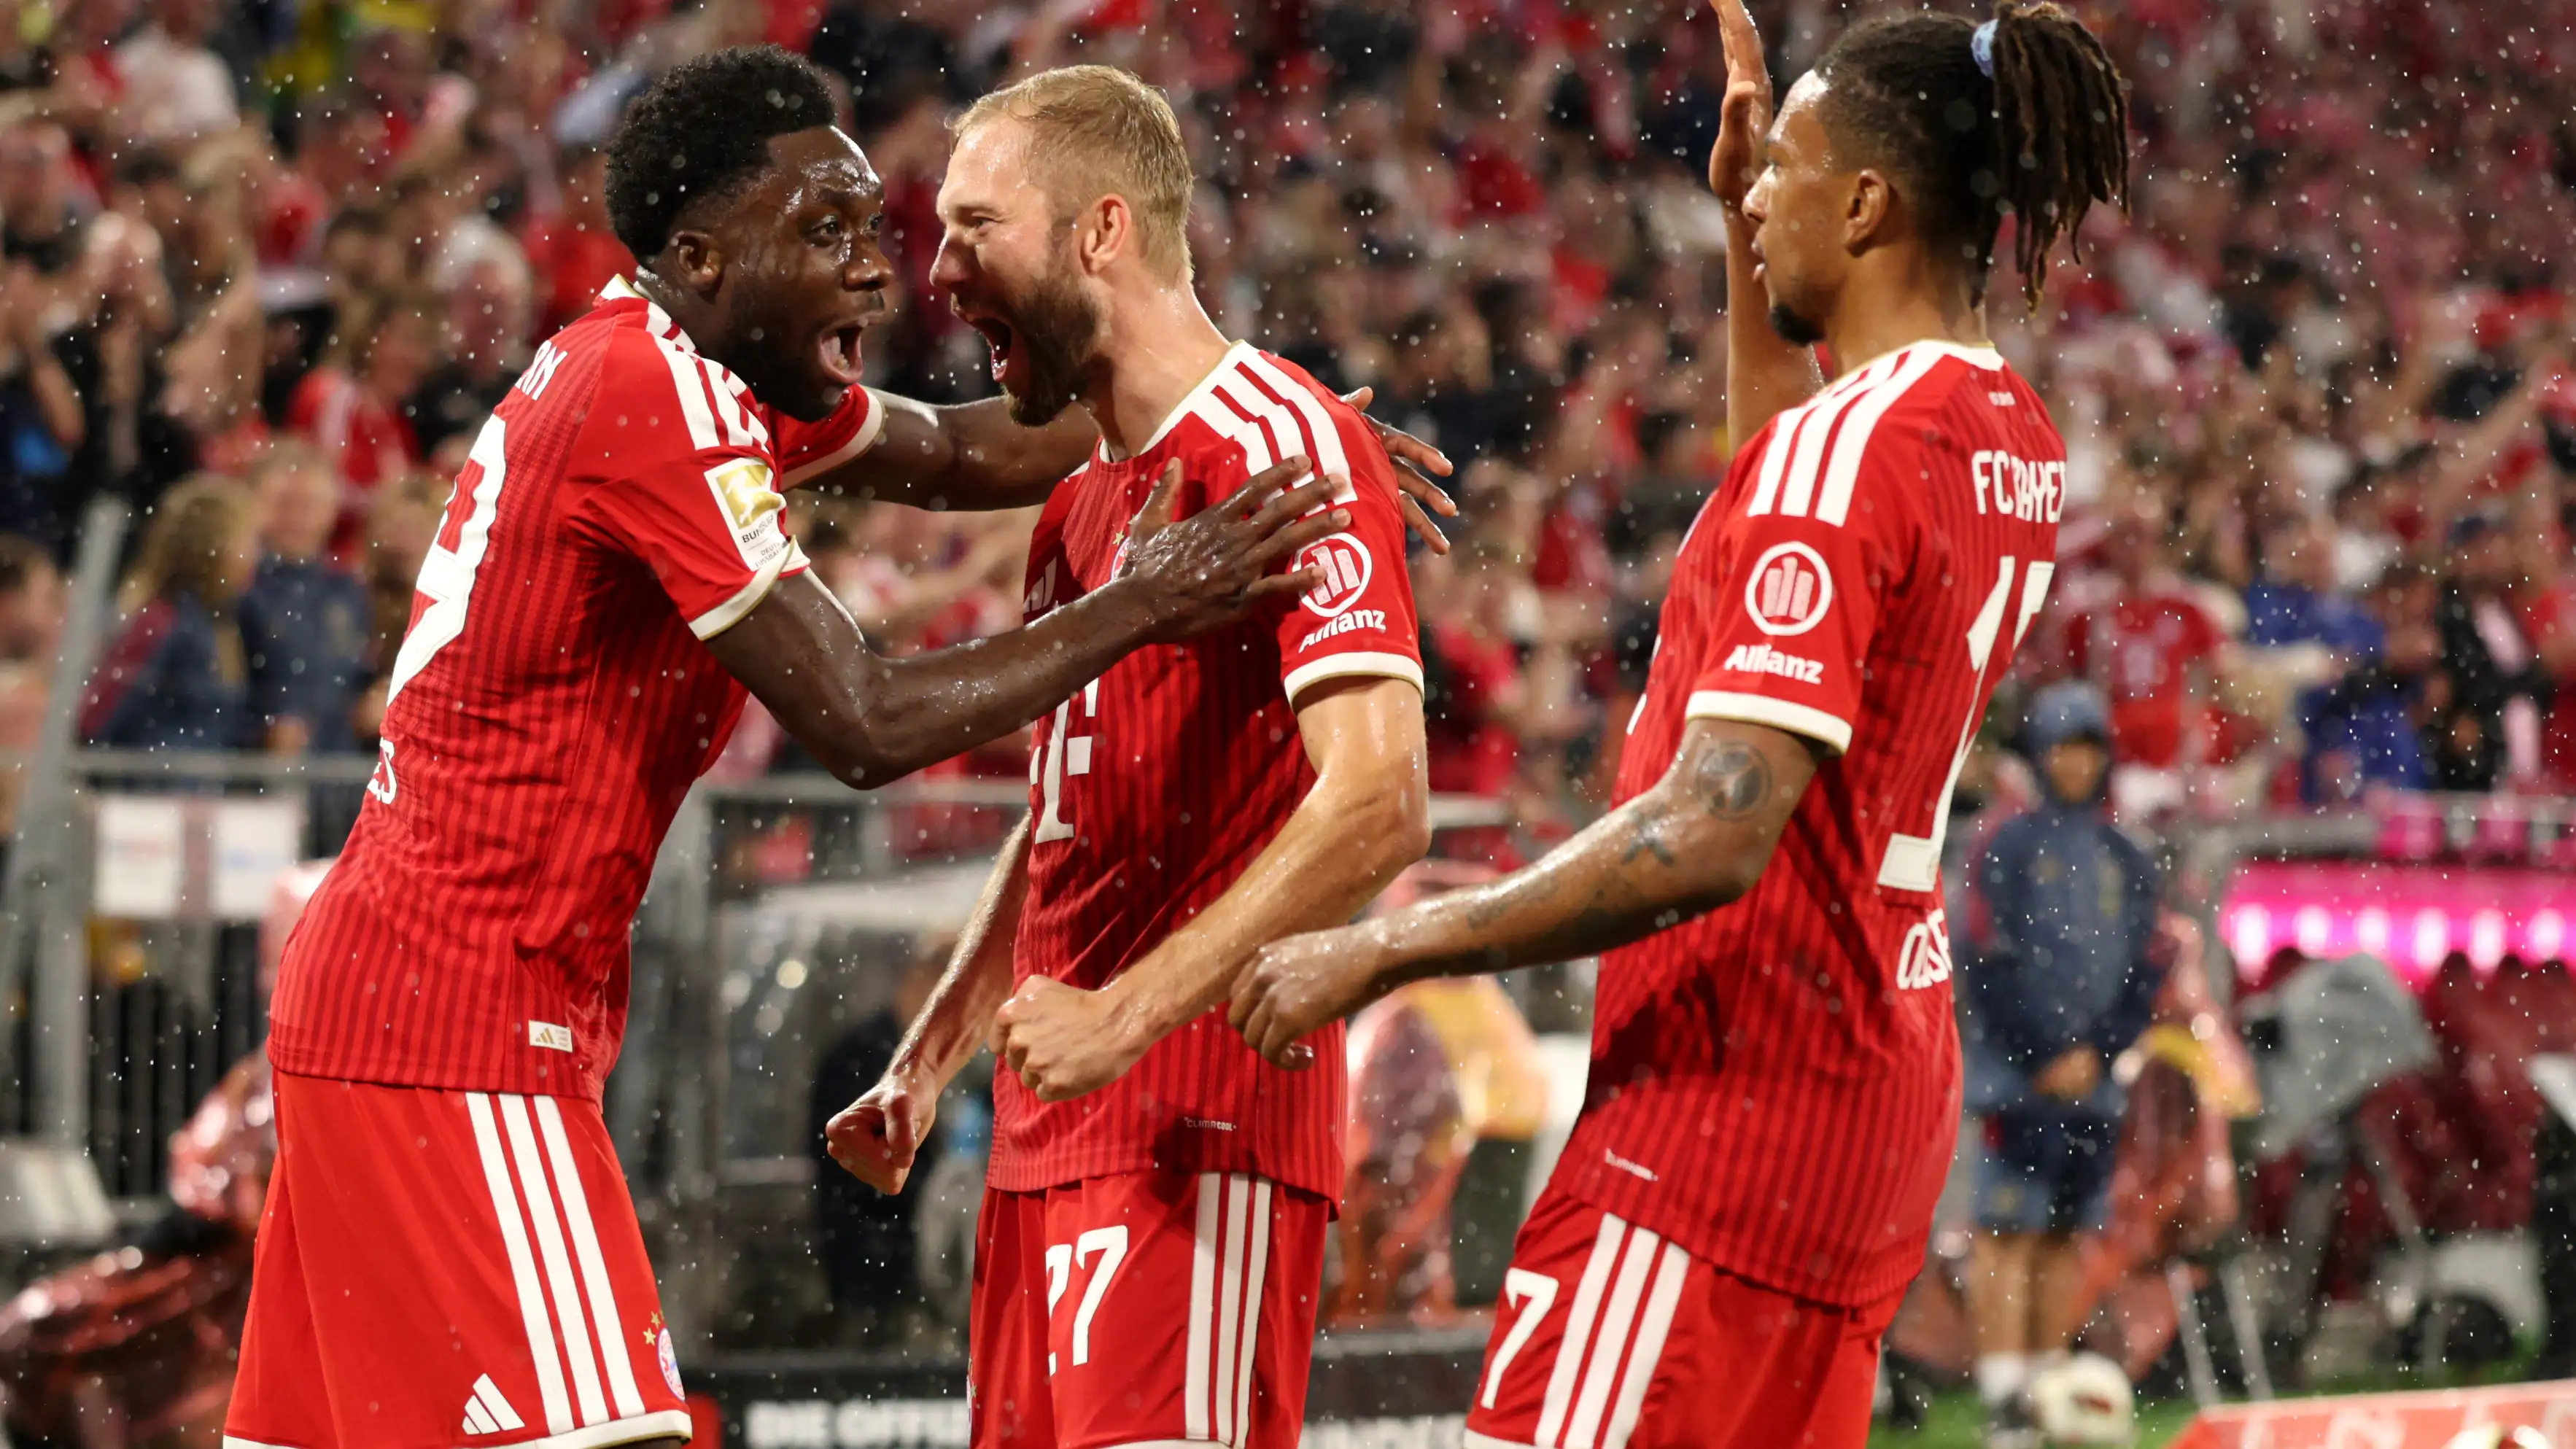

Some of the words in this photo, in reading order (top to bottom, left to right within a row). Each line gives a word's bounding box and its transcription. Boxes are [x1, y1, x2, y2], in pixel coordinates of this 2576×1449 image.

[1298, 607, 1386, 653] Allianz
[1723, 642, 1825, 685] Allianz
[1045, 1225, 1128, 1377] 27
[1481, 1267, 1559, 1410] 7
